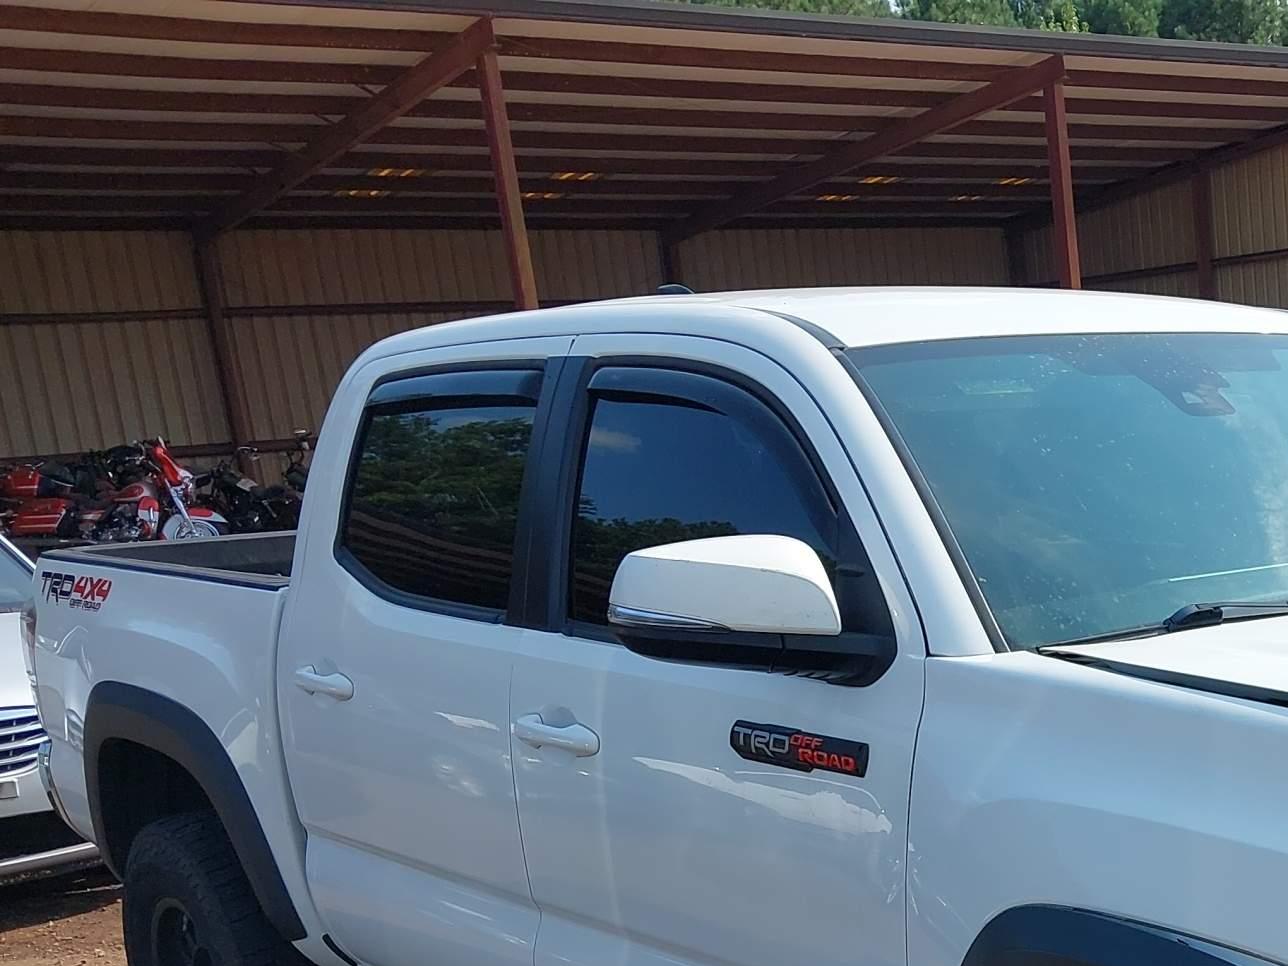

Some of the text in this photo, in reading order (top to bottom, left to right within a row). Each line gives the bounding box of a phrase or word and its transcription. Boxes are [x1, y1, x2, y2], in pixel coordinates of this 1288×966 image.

[41, 571, 76, 604] TRD
[734, 726, 790, 758] TRD
[789, 734, 824, 750] OFF
[798, 748, 857, 772] ROAD
